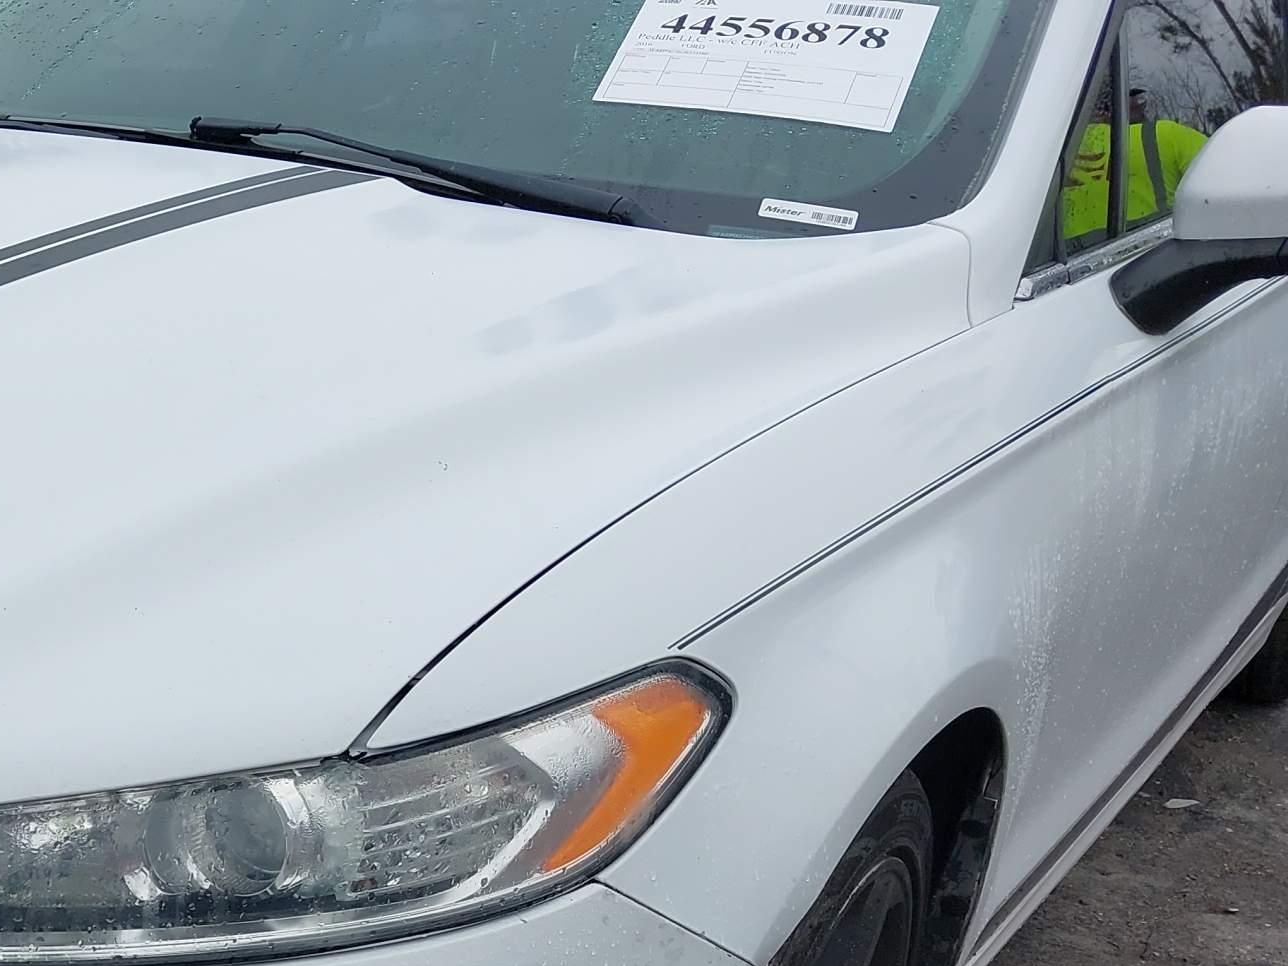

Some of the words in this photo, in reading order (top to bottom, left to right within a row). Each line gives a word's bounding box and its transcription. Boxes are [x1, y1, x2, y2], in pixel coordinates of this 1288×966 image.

[638, 32, 676, 41] Peddle
[660, 13, 891, 50] 44556878
[764, 205, 805, 217] Mister
